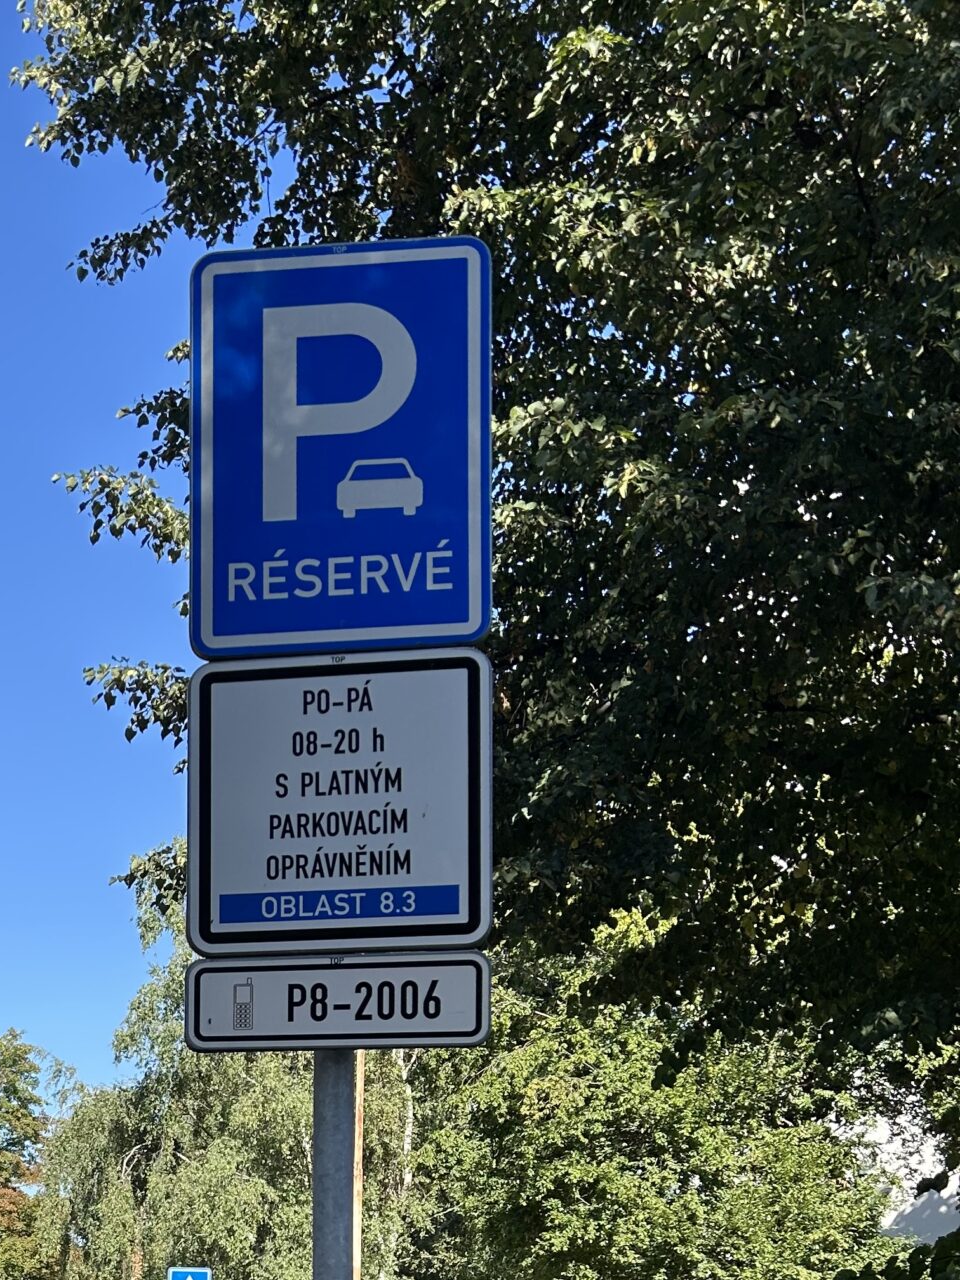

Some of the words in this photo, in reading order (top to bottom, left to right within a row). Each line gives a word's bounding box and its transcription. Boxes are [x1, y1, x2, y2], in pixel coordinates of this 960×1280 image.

[332, 246, 347, 254] TOP
[262, 302, 417, 522] P
[227, 538, 454, 602] RÉSERVÉ
[302, 679, 374, 715] PO-PÁ
[291, 728, 360, 757] 08-20
[373, 727, 385, 752] h
[275, 773, 289, 798] S
[300, 761, 403, 797] PLATNÝM
[268, 802, 409, 839] PARKOVACÍM
[266, 843, 412, 881] OPRÁVNĚNÍM
[260, 892, 367, 919] OBLAST
[379, 890, 416, 914] 8.3
[286, 979, 442, 1023] P8-2006
